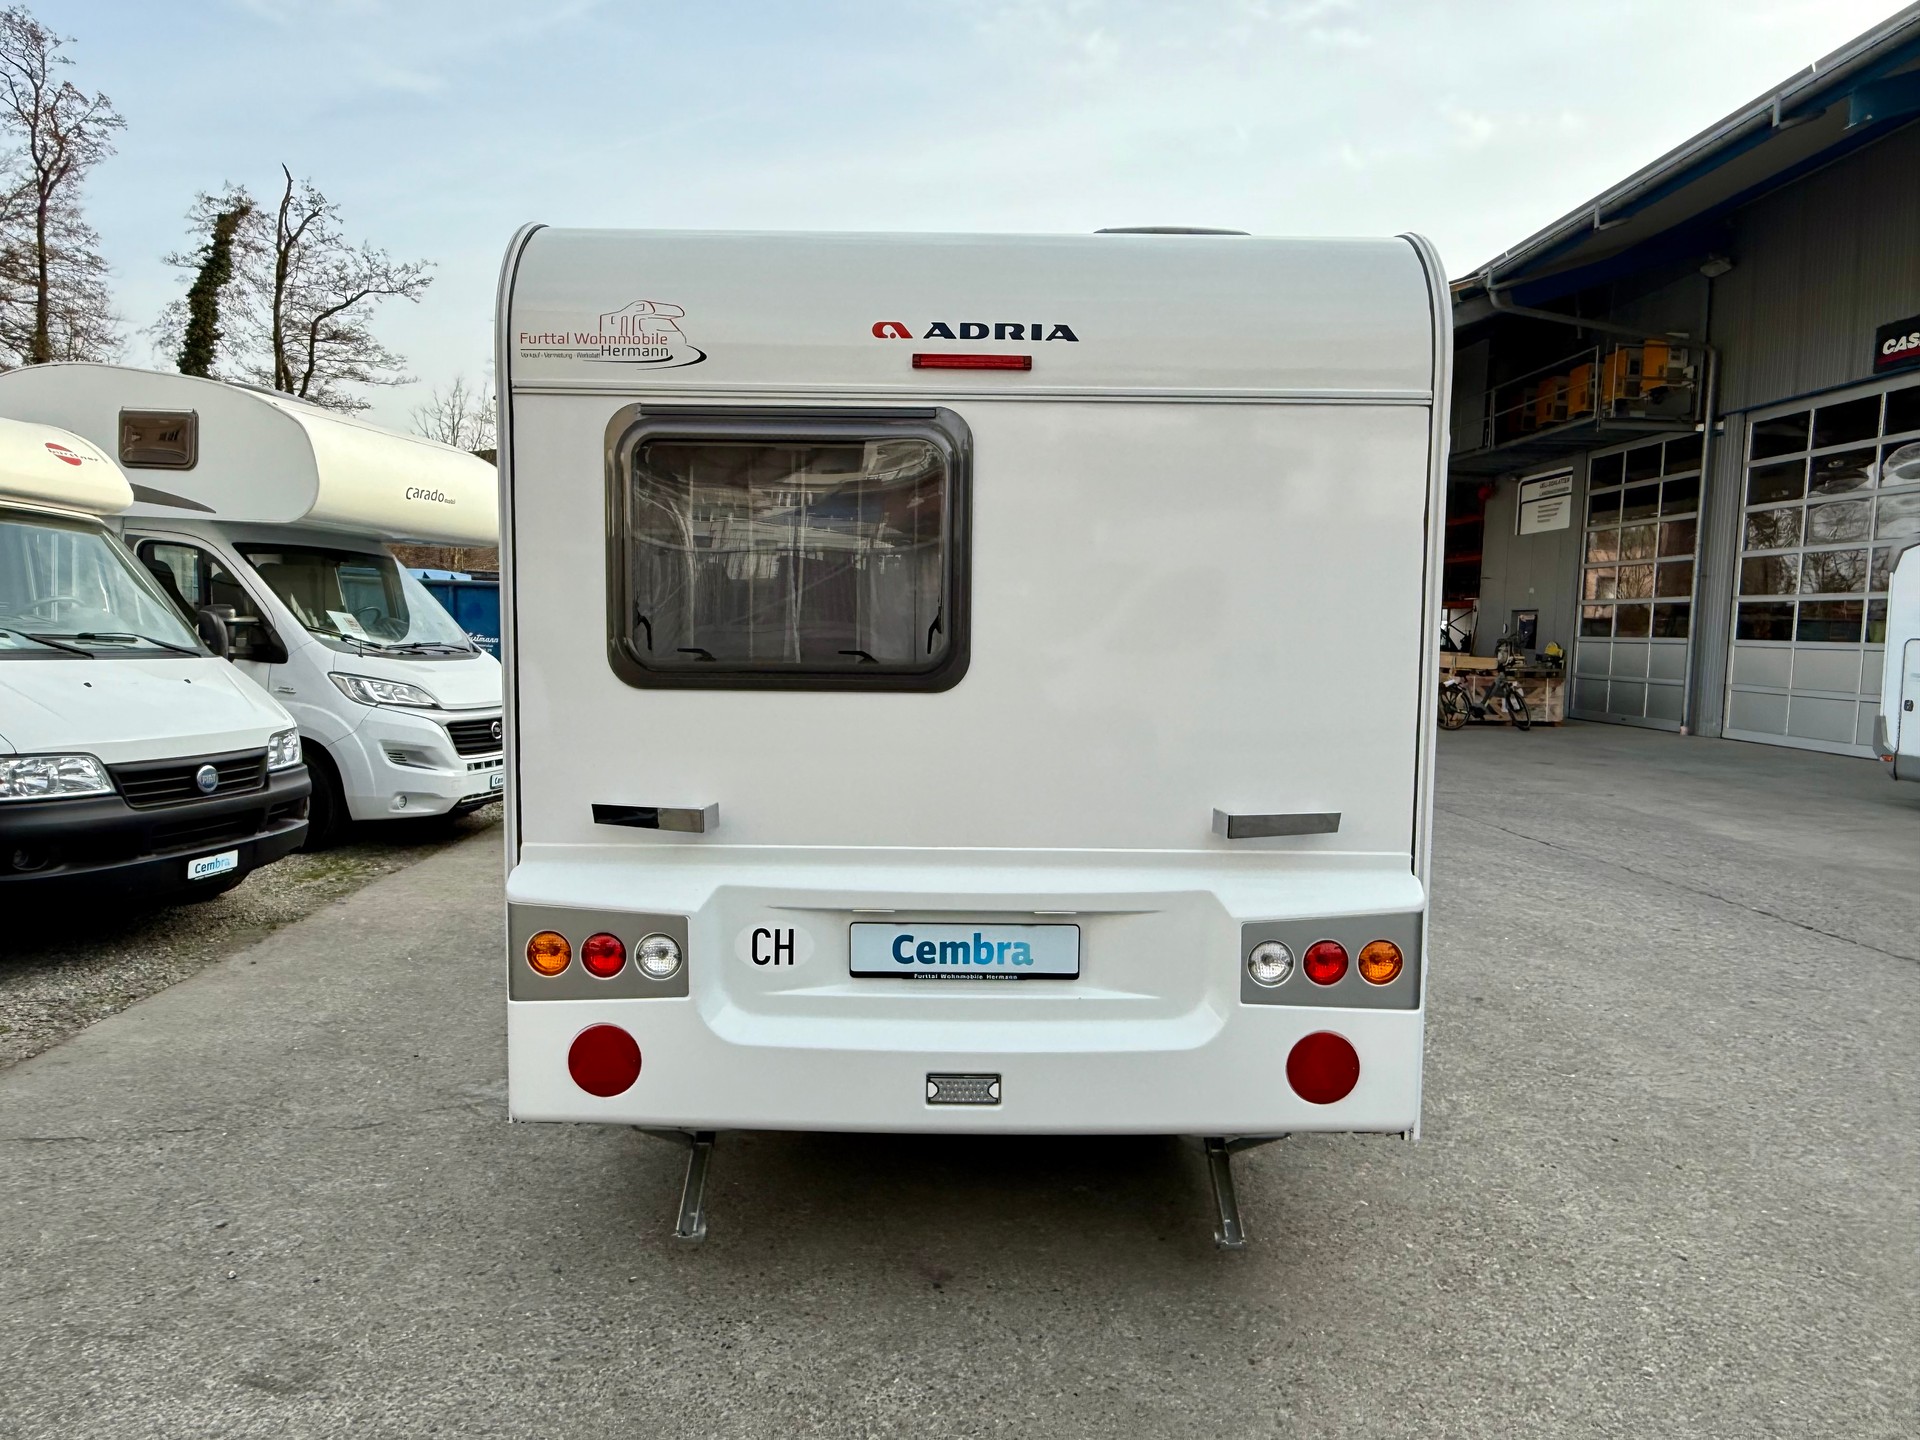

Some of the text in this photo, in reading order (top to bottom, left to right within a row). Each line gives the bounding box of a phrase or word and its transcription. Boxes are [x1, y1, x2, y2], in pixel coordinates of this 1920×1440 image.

[520, 332, 668, 345] Furttal Wohnmobile
[923, 322, 1079, 341] ADRIA
[601, 345, 669, 357] Hermann
[1882, 332, 1920, 355] CAS
[405, 486, 445, 503] Carado
[195, 857, 230, 874] Cembra
[751, 927, 795, 966] CH
[892, 932, 1034, 966] Cembra
